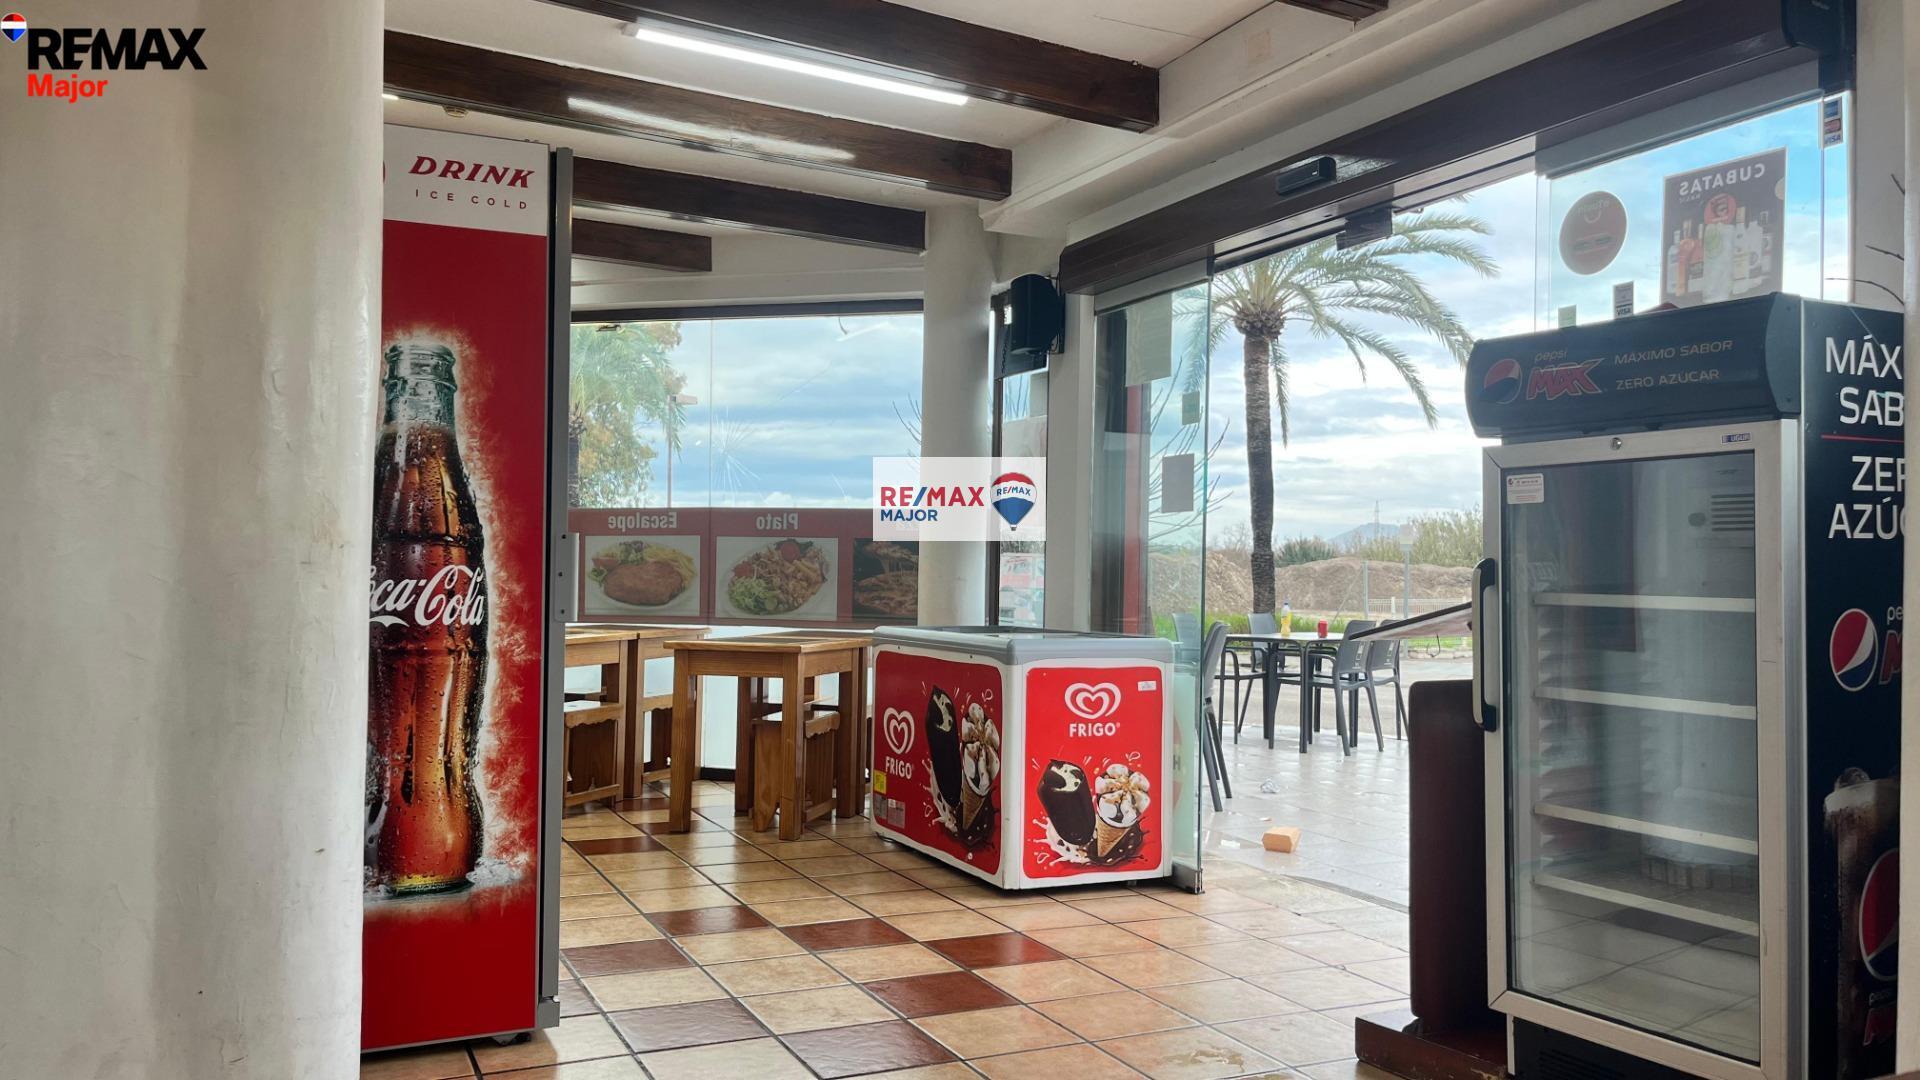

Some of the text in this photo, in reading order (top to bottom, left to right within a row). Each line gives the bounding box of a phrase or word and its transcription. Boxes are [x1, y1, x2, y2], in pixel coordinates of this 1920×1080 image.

[408, 155, 535, 188] DRINK
[415, 189, 527, 210] ICE COLD
[1534, 348, 1568, 363] pepsi
[1680, 340, 1733, 357] SABOR
[1616, 376, 1654, 391] ZERO
[1828, 497, 1905, 539] AZÚ
[1069, 722, 1116, 738] FRIGO
[885, 756, 912, 780] FRIGO
